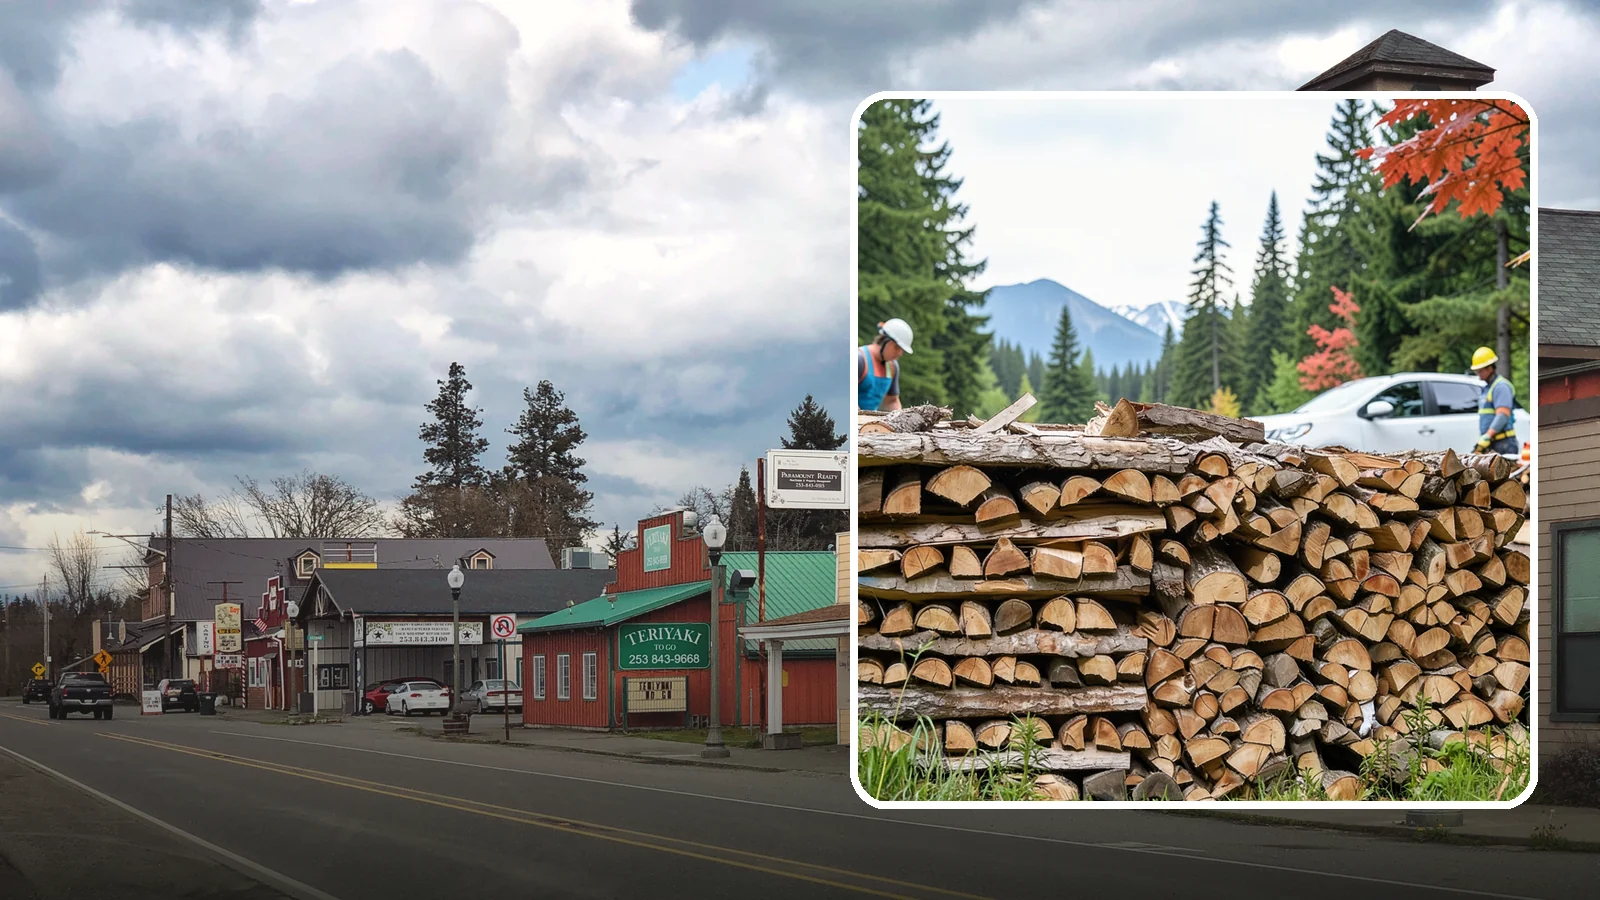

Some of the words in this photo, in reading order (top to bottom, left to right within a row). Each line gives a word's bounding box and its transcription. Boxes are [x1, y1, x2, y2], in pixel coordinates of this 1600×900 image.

[646, 531, 669, 549] TERIYAKI
[625, 627, 702, 646] TERIYAKI
[629, 655, 648, 664] 253
[652, 654, 700, 664] 843-9668
[639, 681, 672, 691] TERIYAKI
